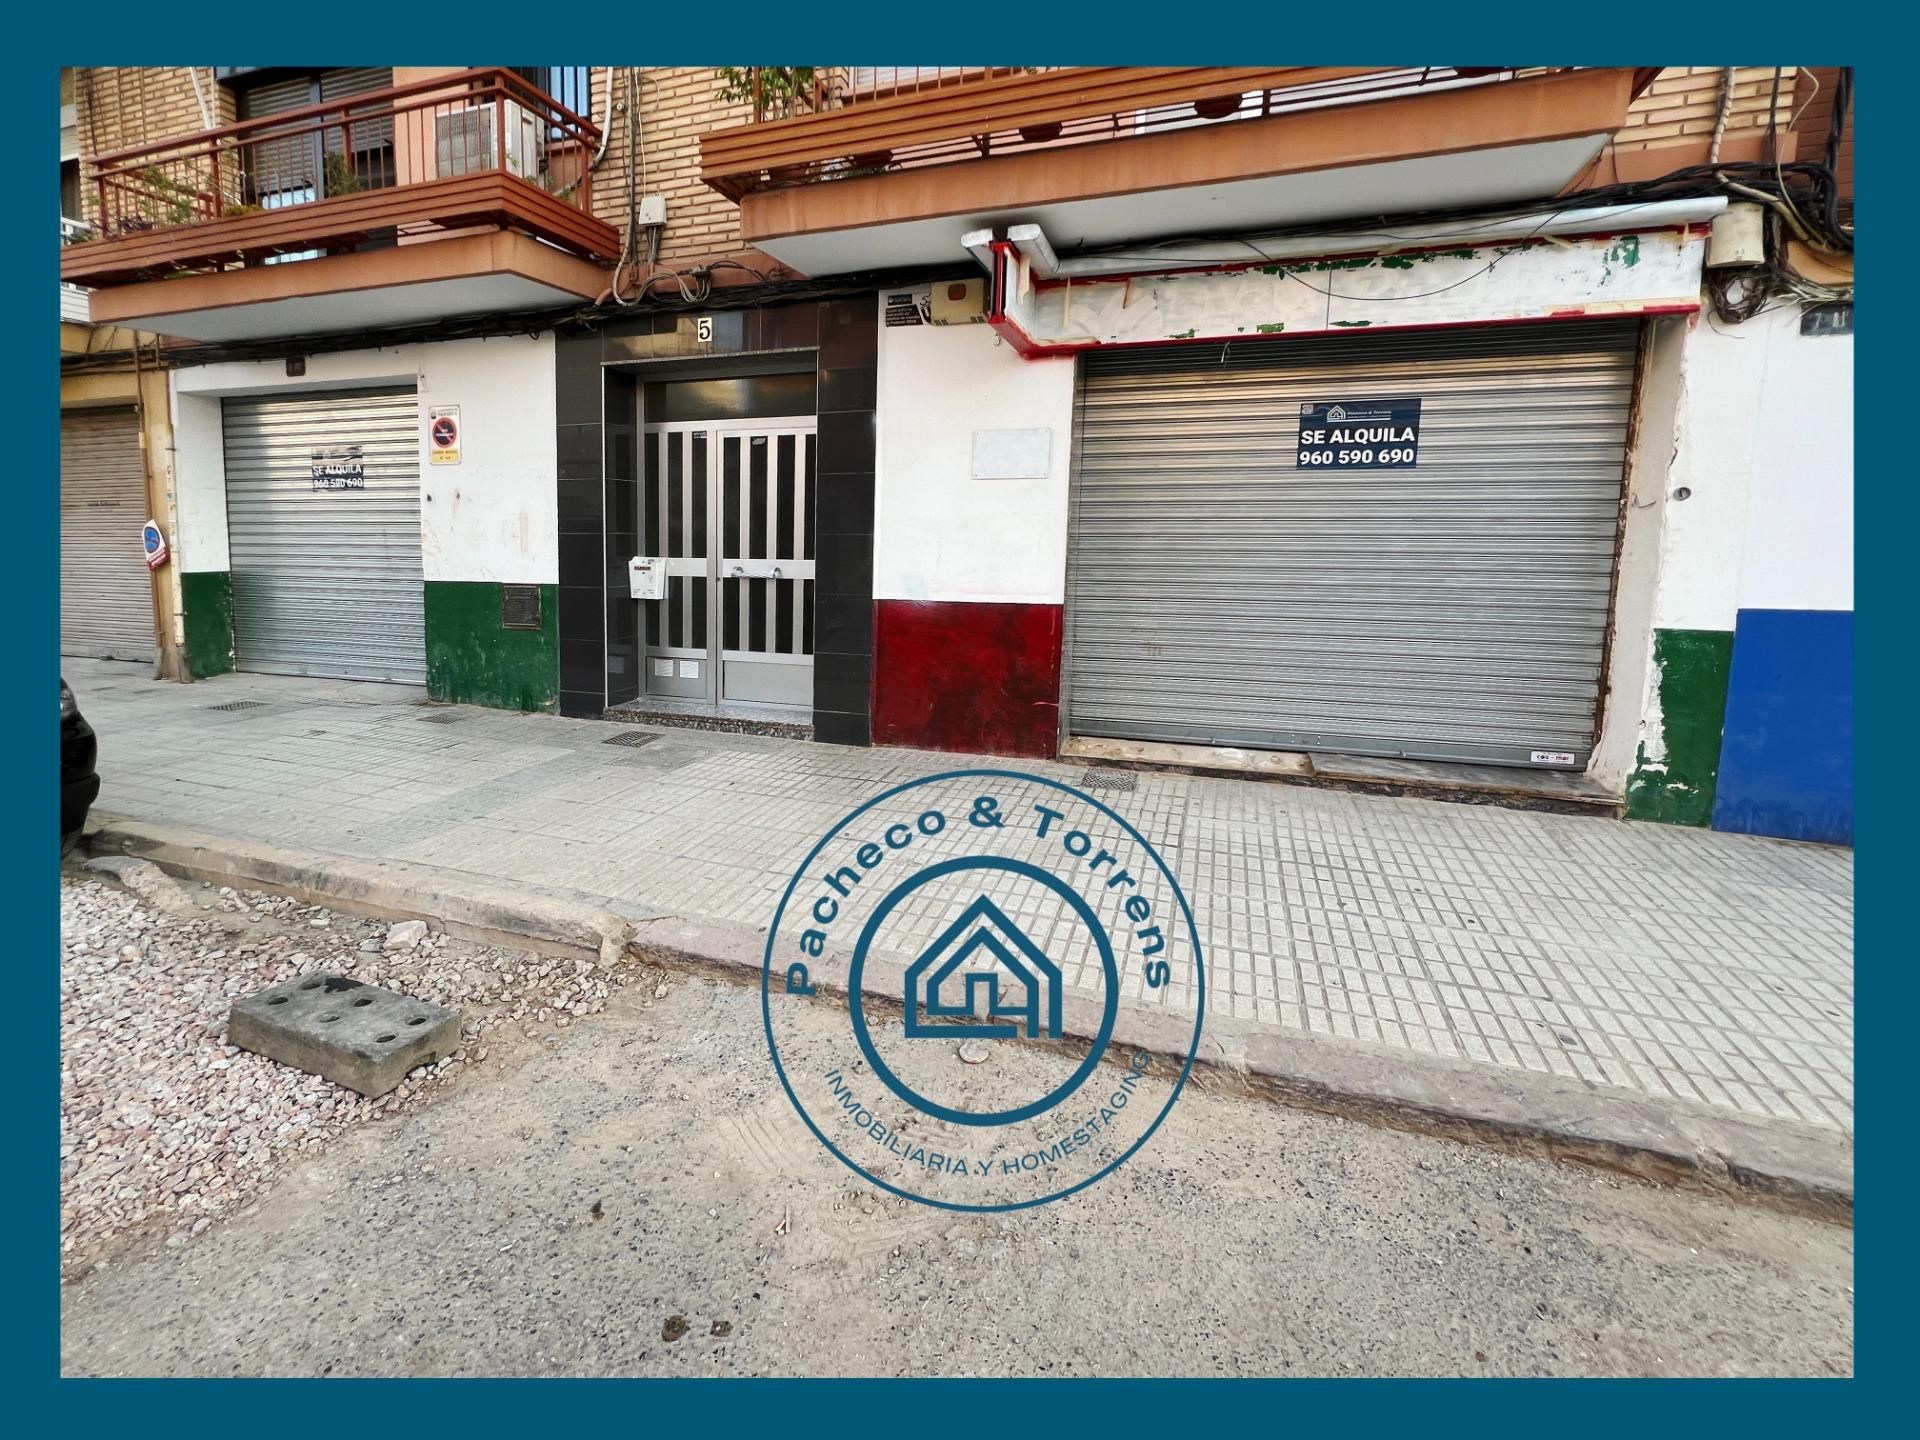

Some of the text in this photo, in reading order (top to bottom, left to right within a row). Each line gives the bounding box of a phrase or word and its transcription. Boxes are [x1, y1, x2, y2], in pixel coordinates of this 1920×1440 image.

[699, 319, 711, 340] 5
[1301, 427, 1416, 445] SE ALQUILA
[1299, 448, 1414, 466] 960 590 690
[313, 464, 362, 476] SE ALQUILA
[346, 477, 363, 487] 690
